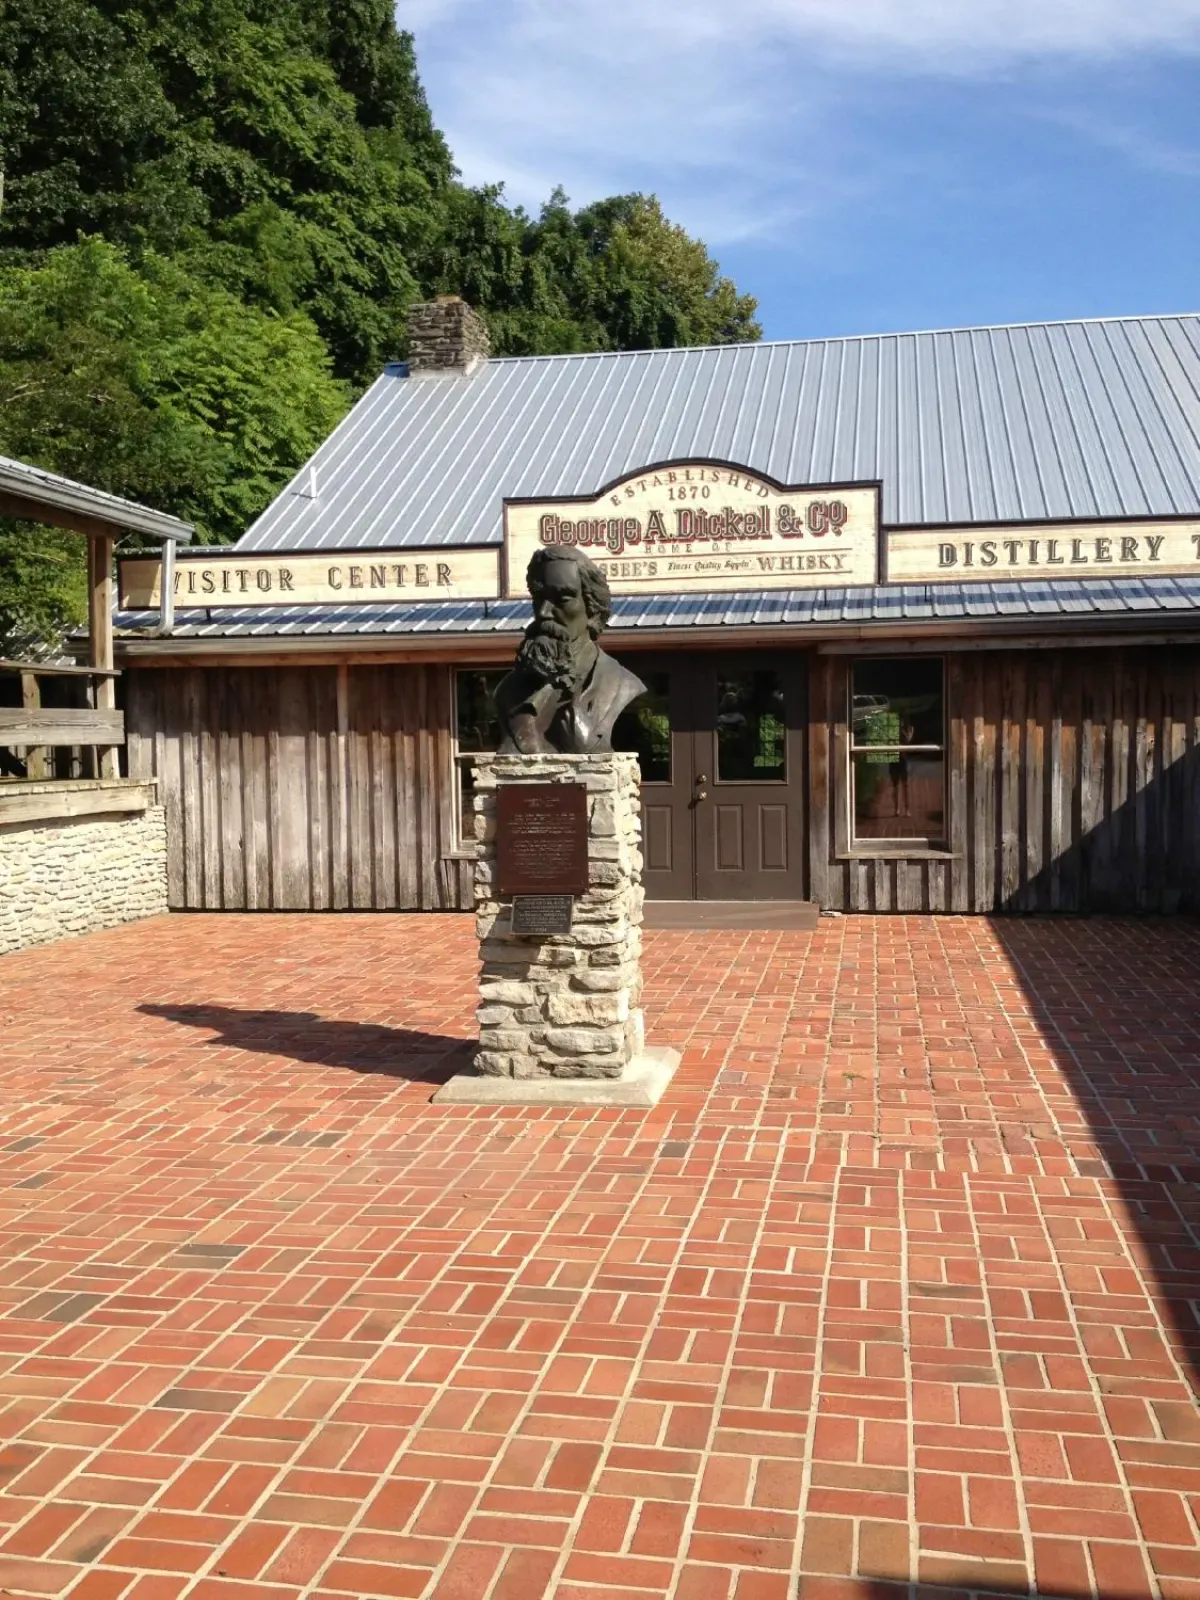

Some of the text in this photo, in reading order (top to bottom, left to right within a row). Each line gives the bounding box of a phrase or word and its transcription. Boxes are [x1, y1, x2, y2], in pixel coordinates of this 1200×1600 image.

[610, 469, 769, 507] ESTABLISHED
[668, 486, 710, 501] 1870
[539, 512, 641, 555] George
[775, 503, 803, 539] &
[644, 542, 734, 554] HOME OF
[938, 534, 1165, 568] DISTILLERY
[327, 562, 453, 590] CENTER
[599, 560, 658, 577] SSEE'S
[756, 553, 848, 571] WHISKY
